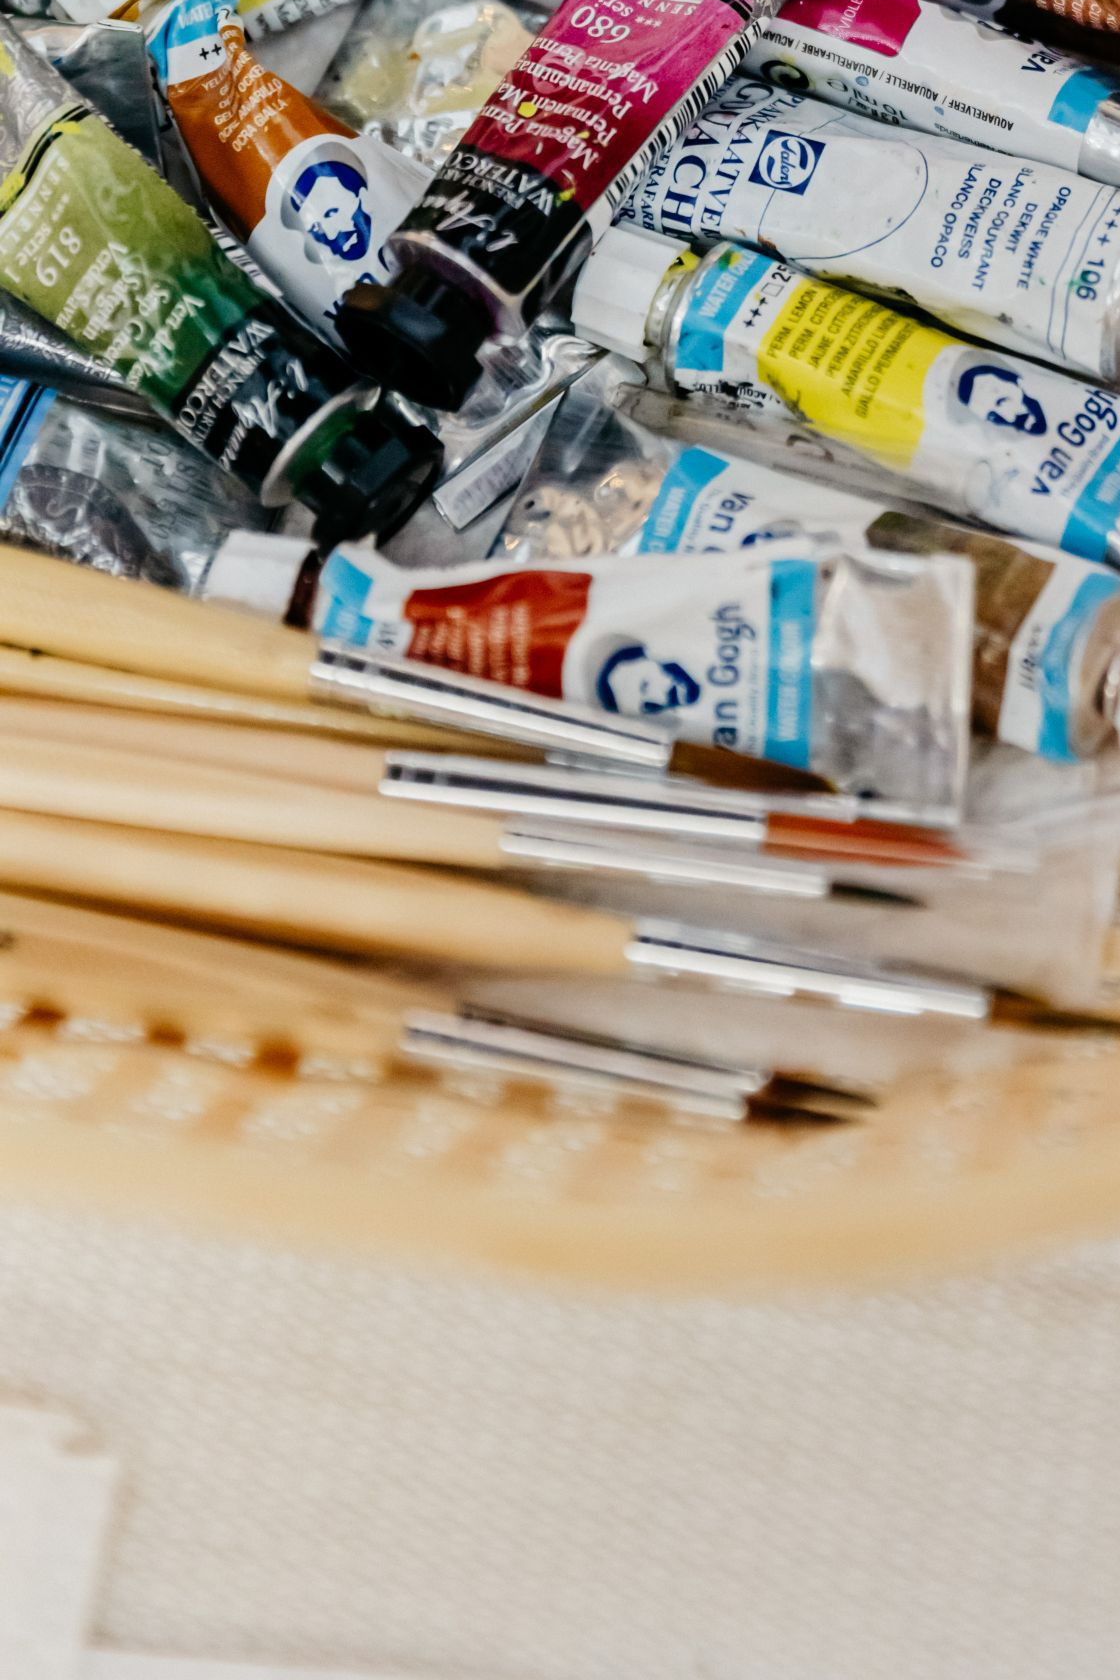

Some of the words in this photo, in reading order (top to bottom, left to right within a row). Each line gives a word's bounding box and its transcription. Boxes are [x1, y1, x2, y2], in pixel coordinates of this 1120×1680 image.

[567, 0, 632, 46] 680
[585, 55, 659, 103] Magenta
[800, 41, 878, 79] AQUARELLFARBE
[880, 102, 906, 120] 10
[885, 73, 938, 101] AQUARELLE
[529, 95, 619, 145] Permanent
[947, 96, 1013, 132] AQUARELVERF
[524, 122, 600, 170] Magenta
[956, 177, 1001, 260] DECKWEISS
[1003, 201, 1037, 254] DEKWIT
[1035, 185, 1072, 238] OPAQUE
[12, 221, 54, 268] serie
[36, 225, 85, 289] 819
[929, 210, 958, 269] OPACO
[970, 209, 1009, 291] COUVRANT
[1015, 239, 1044, 290] WHITE
[1073, 254, 1107, 303] 106
[1023, 444, 1074, 502] van
[706, 601, 755, 685] Gogh
[711, 698, 740, 747] an
